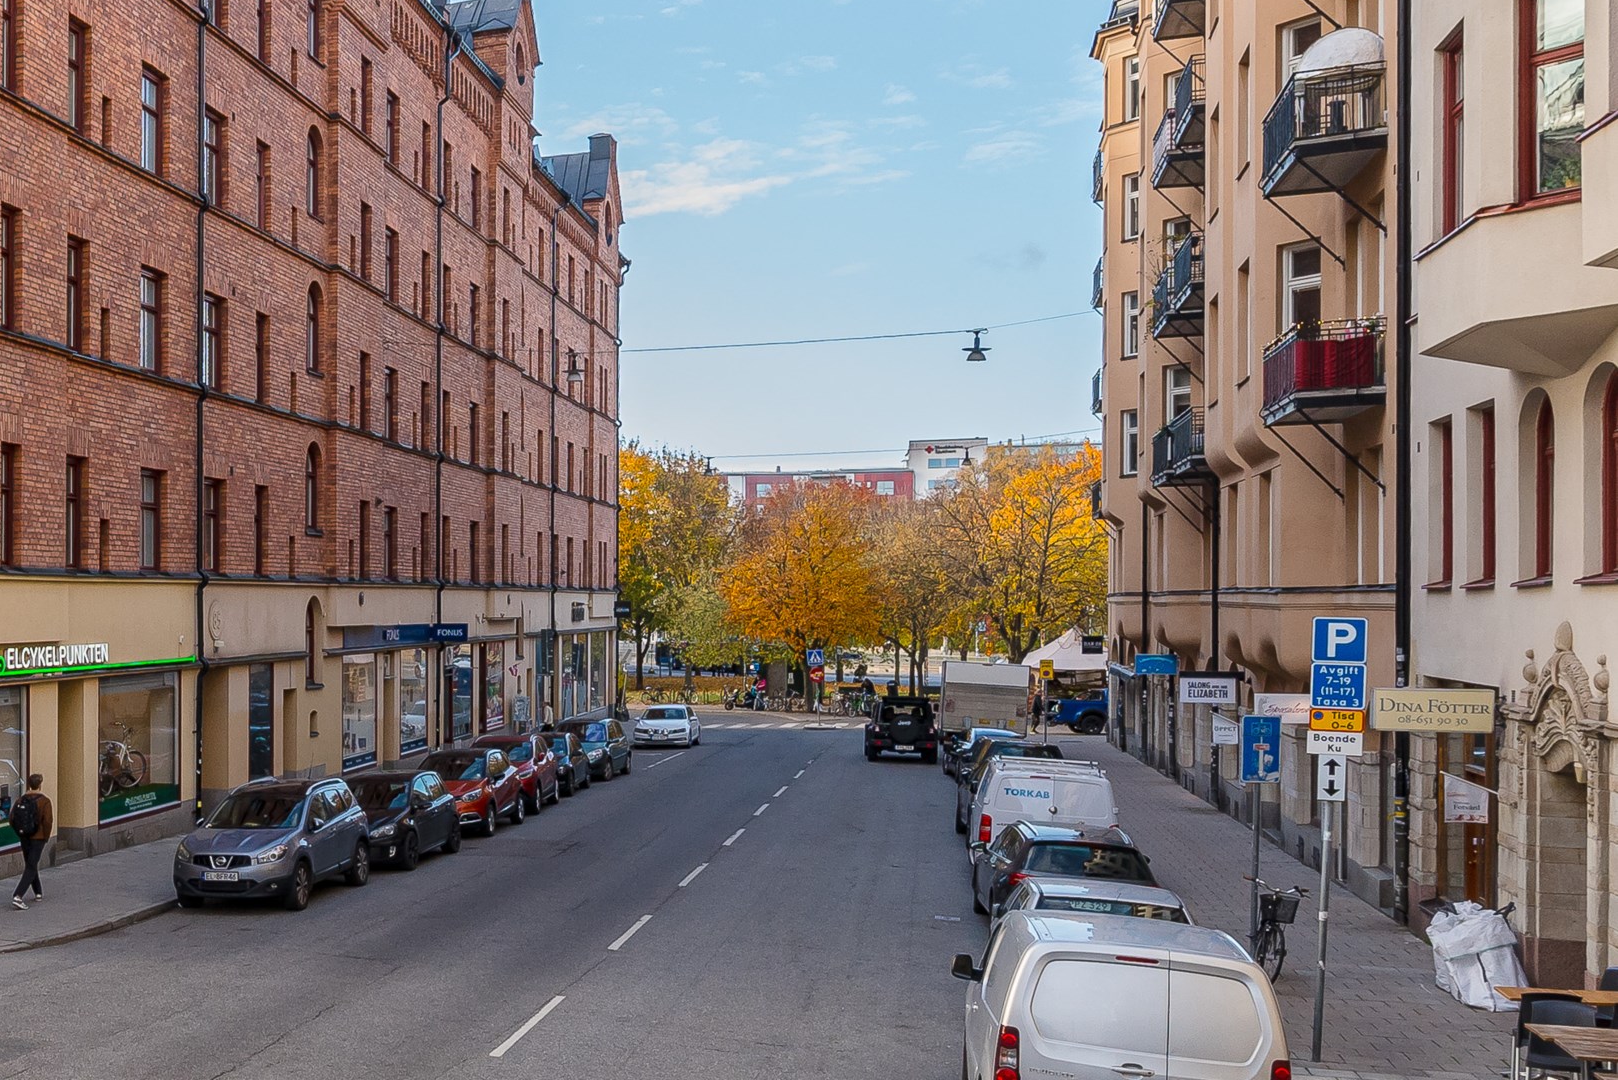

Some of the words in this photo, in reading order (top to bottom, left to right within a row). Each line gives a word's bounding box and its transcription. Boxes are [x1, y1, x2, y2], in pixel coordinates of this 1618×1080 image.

[436, 628, 464, 637] FONUS
[1327, 622, 1357, 658] P
[6, 643, 109, 670] ELCYKELPUNKTEN
[1319, 665, 1359, 676] Avgift
[1187, 681, 1211, 689] SALONG
[1325, 676, 1351, 685] 7-19
[1187, 689, 1228, 699] ELIZABETH
[1320, 686, 1355, 697] (11-17)
[1316, 697, 1347, 707] Taxa
[1352, 698, 1360, 707] 3
[1379, 698, 1423, 713] DINA
[1331, 711, 1355, 720] Tisd
[1397, 715, 1433, 726] 08-651
[1437, 717, 1452, 726] 90
[1456, 718, 1469, 726] 30
[1213, 724, 1237, 733] ÖPPET
[1313, 733, 1357, 744] Boende
[1327, 744, 1342, 753] Ku
[1003, 787, 1050, 799] TORKAB
